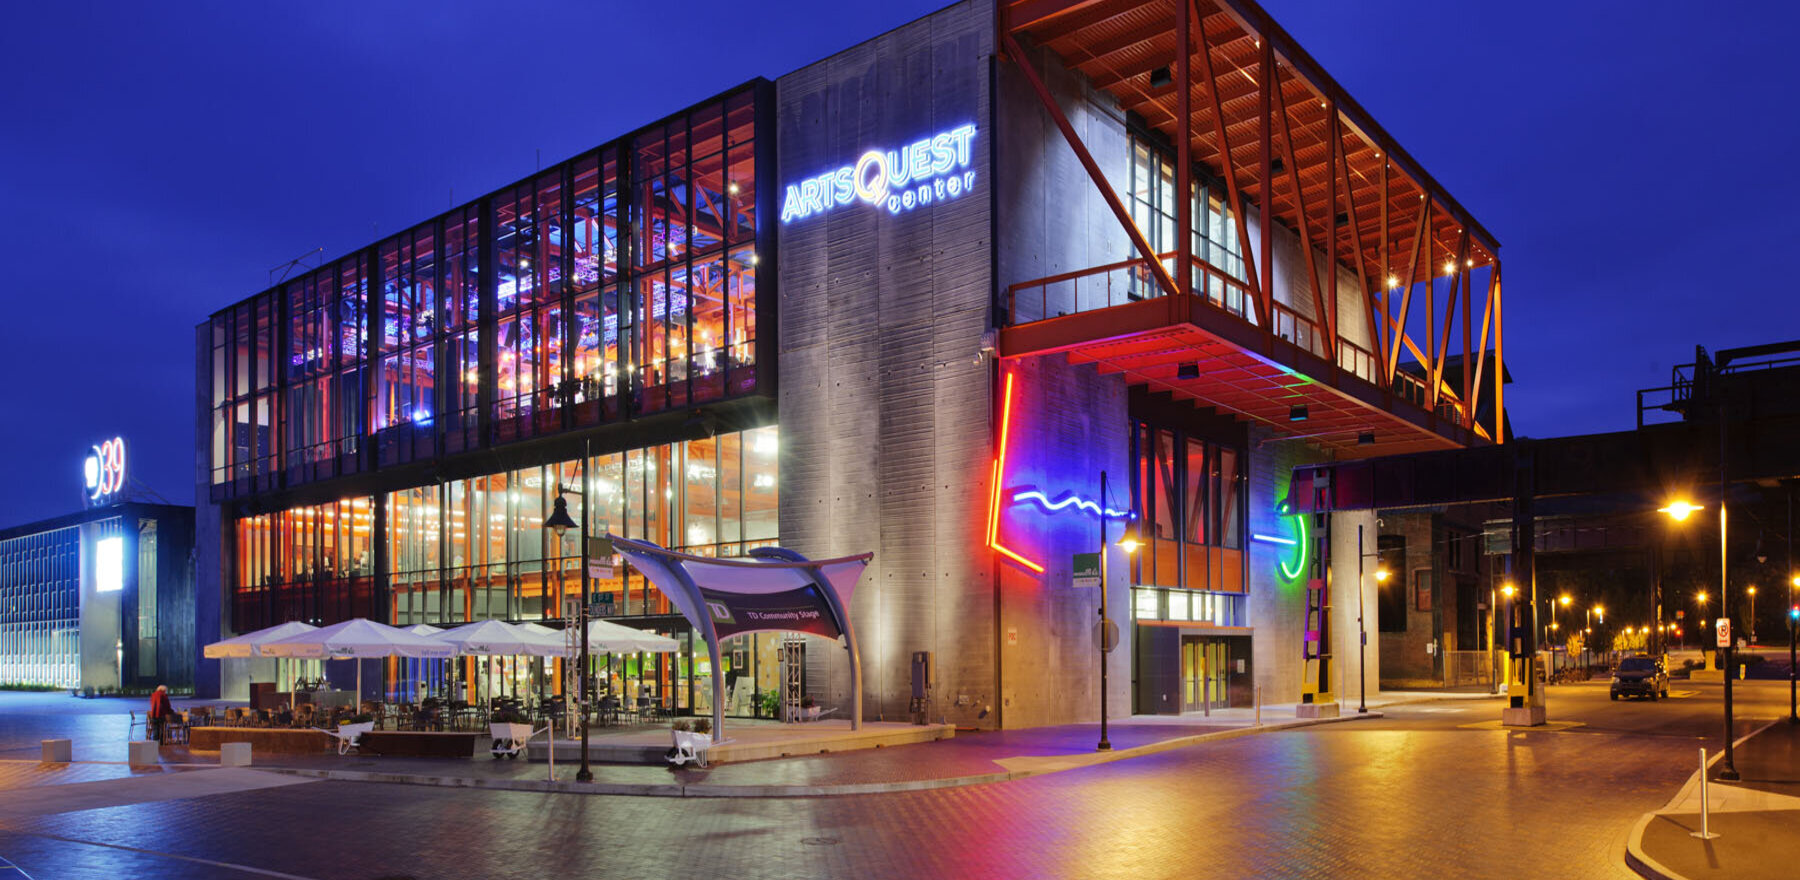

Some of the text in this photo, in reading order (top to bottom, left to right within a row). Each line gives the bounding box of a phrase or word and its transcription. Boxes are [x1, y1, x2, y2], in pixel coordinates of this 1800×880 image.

[781, 124, 976, 222] ARTSQUEST
[887, 171, 976, 215] center
[706, 602, 730, 619] TD
[746, 609, 820, 621] TD Community Stage
